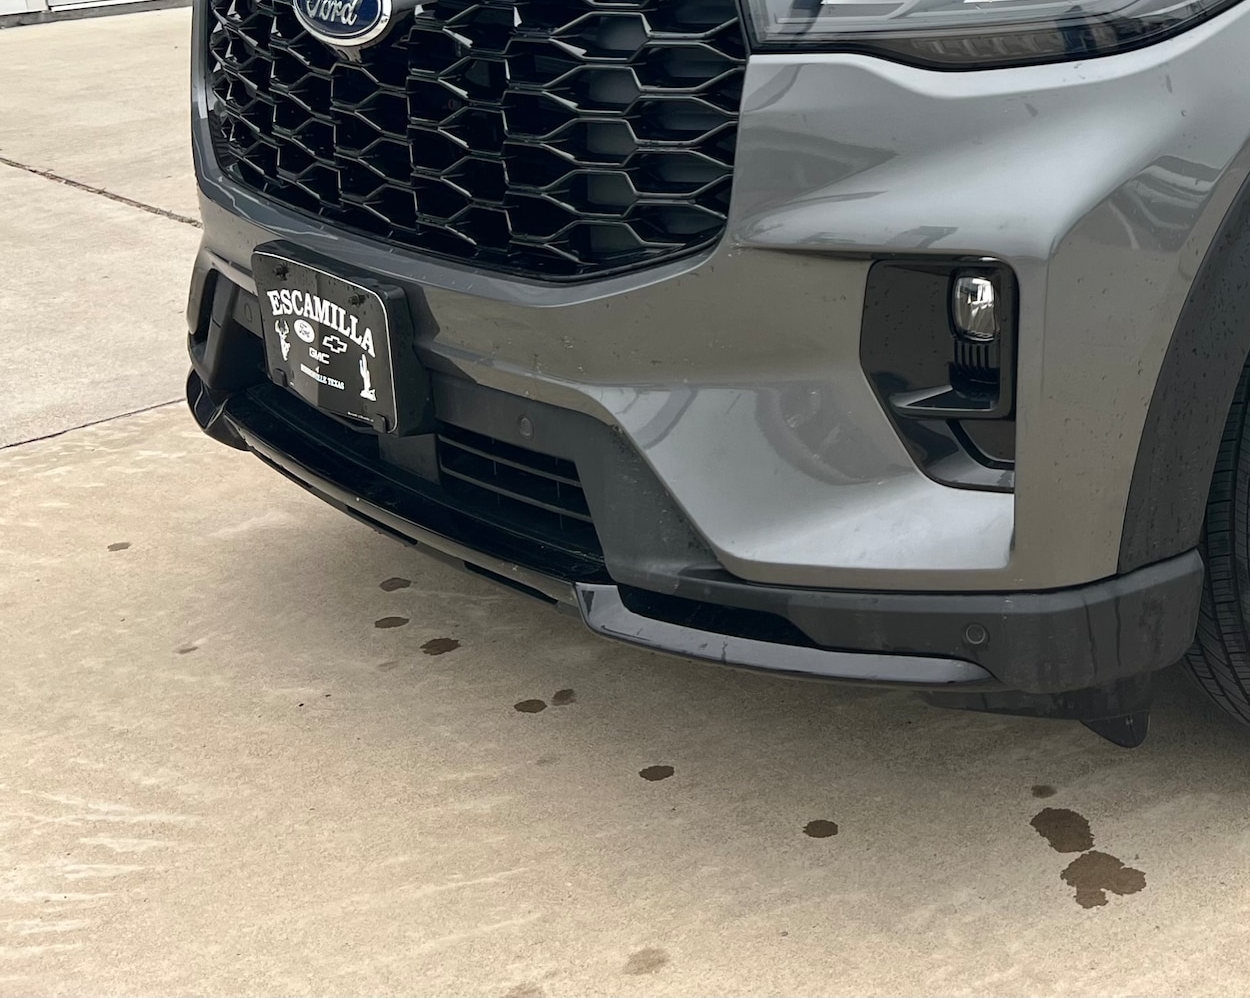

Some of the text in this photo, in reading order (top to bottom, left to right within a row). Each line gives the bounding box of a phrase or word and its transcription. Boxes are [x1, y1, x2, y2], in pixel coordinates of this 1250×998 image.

[266, 288, 376, 359] ESCAMILLA
[308, 346, 330, 365] GMC
[327, 375, 345, 390] TEXAS
